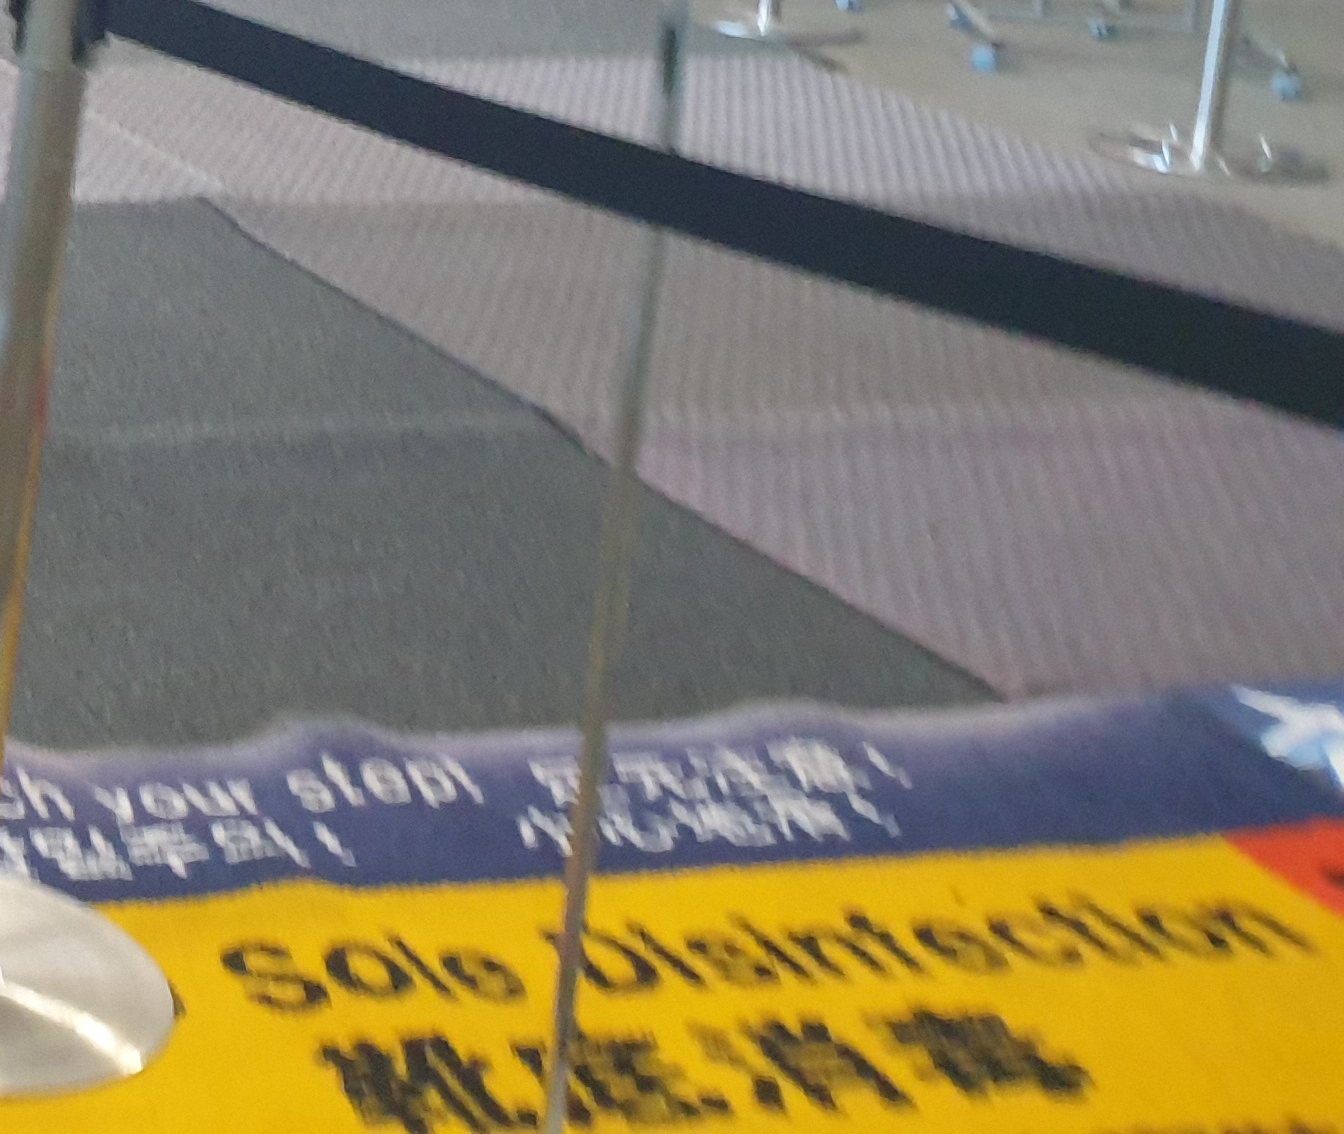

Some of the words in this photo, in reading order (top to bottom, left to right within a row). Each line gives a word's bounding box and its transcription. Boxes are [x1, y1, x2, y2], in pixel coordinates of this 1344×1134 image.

[94, 777, 261, 824] your
[220, 936, 527, 1013] Sole
[544, 892, 1320, 995] Disinfection
